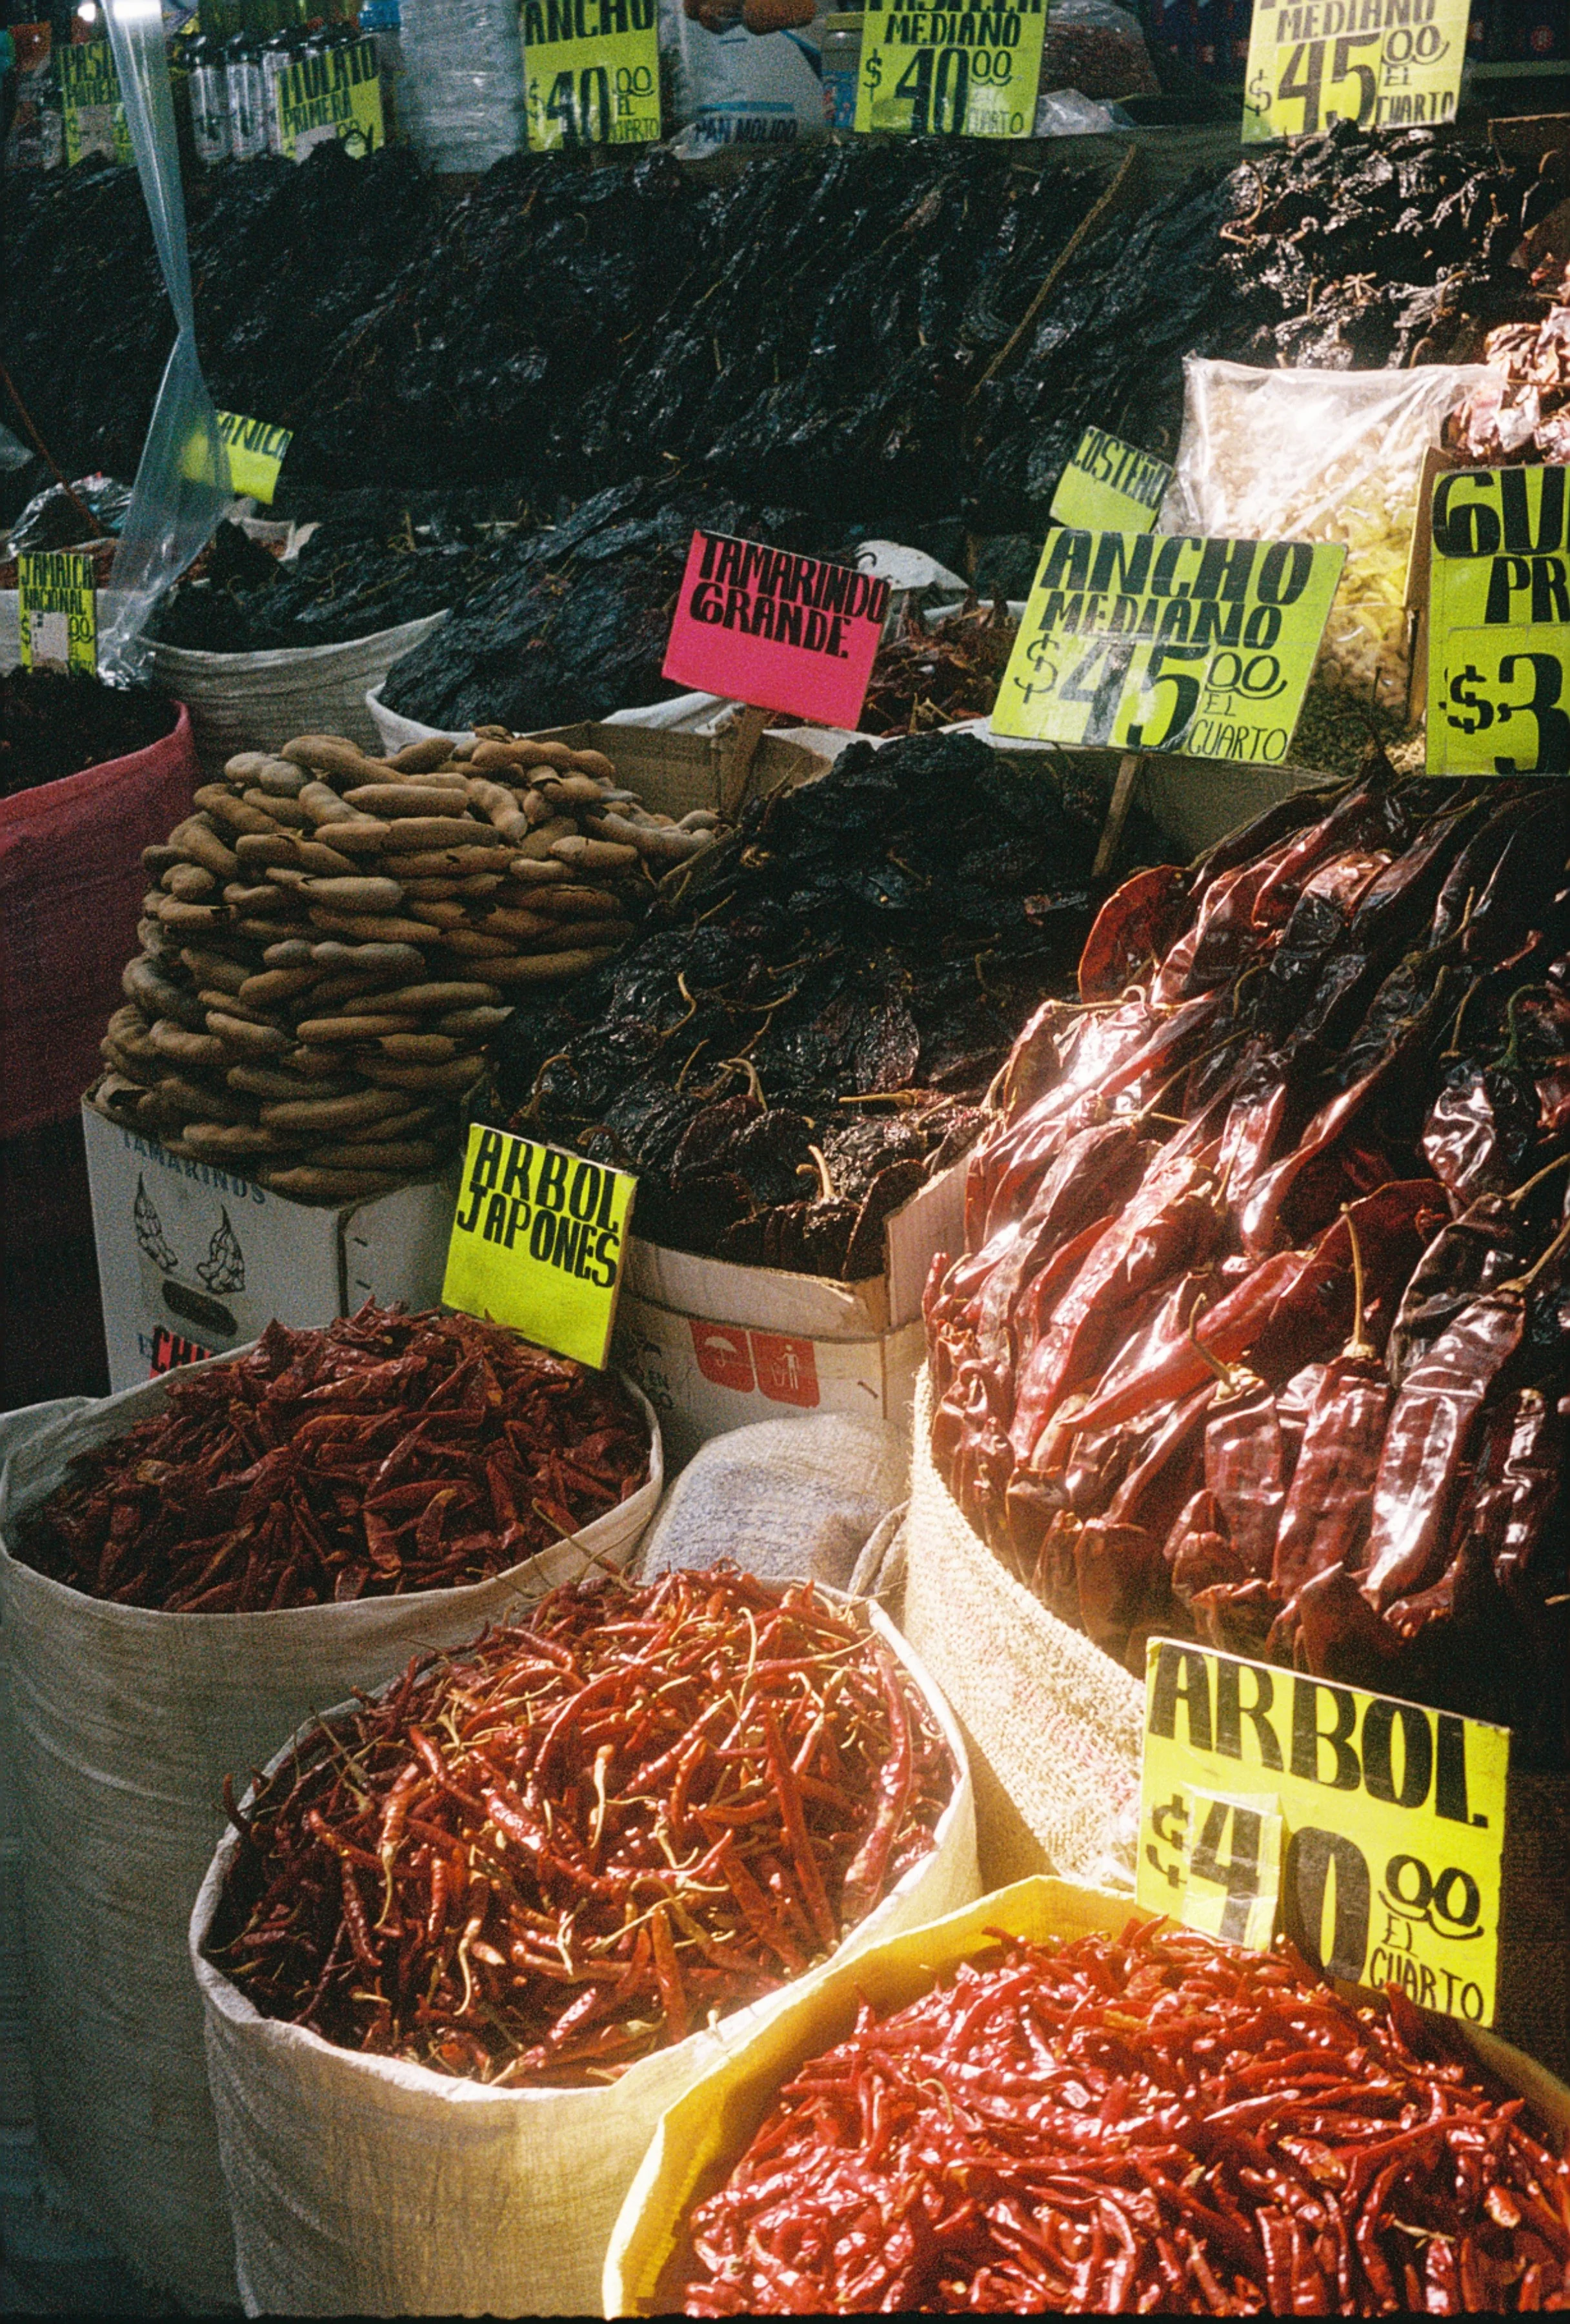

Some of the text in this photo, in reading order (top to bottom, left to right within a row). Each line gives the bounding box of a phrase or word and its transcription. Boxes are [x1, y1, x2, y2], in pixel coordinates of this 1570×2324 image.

[524, 0, 654, 46] ANCHO
[885, 13, 1021, 48] MEDIANO
[1277, 0, 1434, 43] MEDIANO
[1433, 466, 1570, 557] GU
[21, 552, 95, 589] JAMAICA
[699, 530, 891, 624] TAMARINDO
[1039, 529, 1314, 605] ANCHO
[690, 581, 852, 659] GRANDE
[1038, 591, 1283, 651] MEDIANO
[1203, 693, 1236, 717] EL
[1187, 720, 1288, 762] CUARTO
[472, 1128, 619, 1233] ARBOL
[457, 1181, 621, 1288] JAPONES
[1148, 1641, 1489, 1829] ARBOL
[1384, 1913, 1418, 1958] EL
[1370, 1946, 1484, 2023] CUARTO
